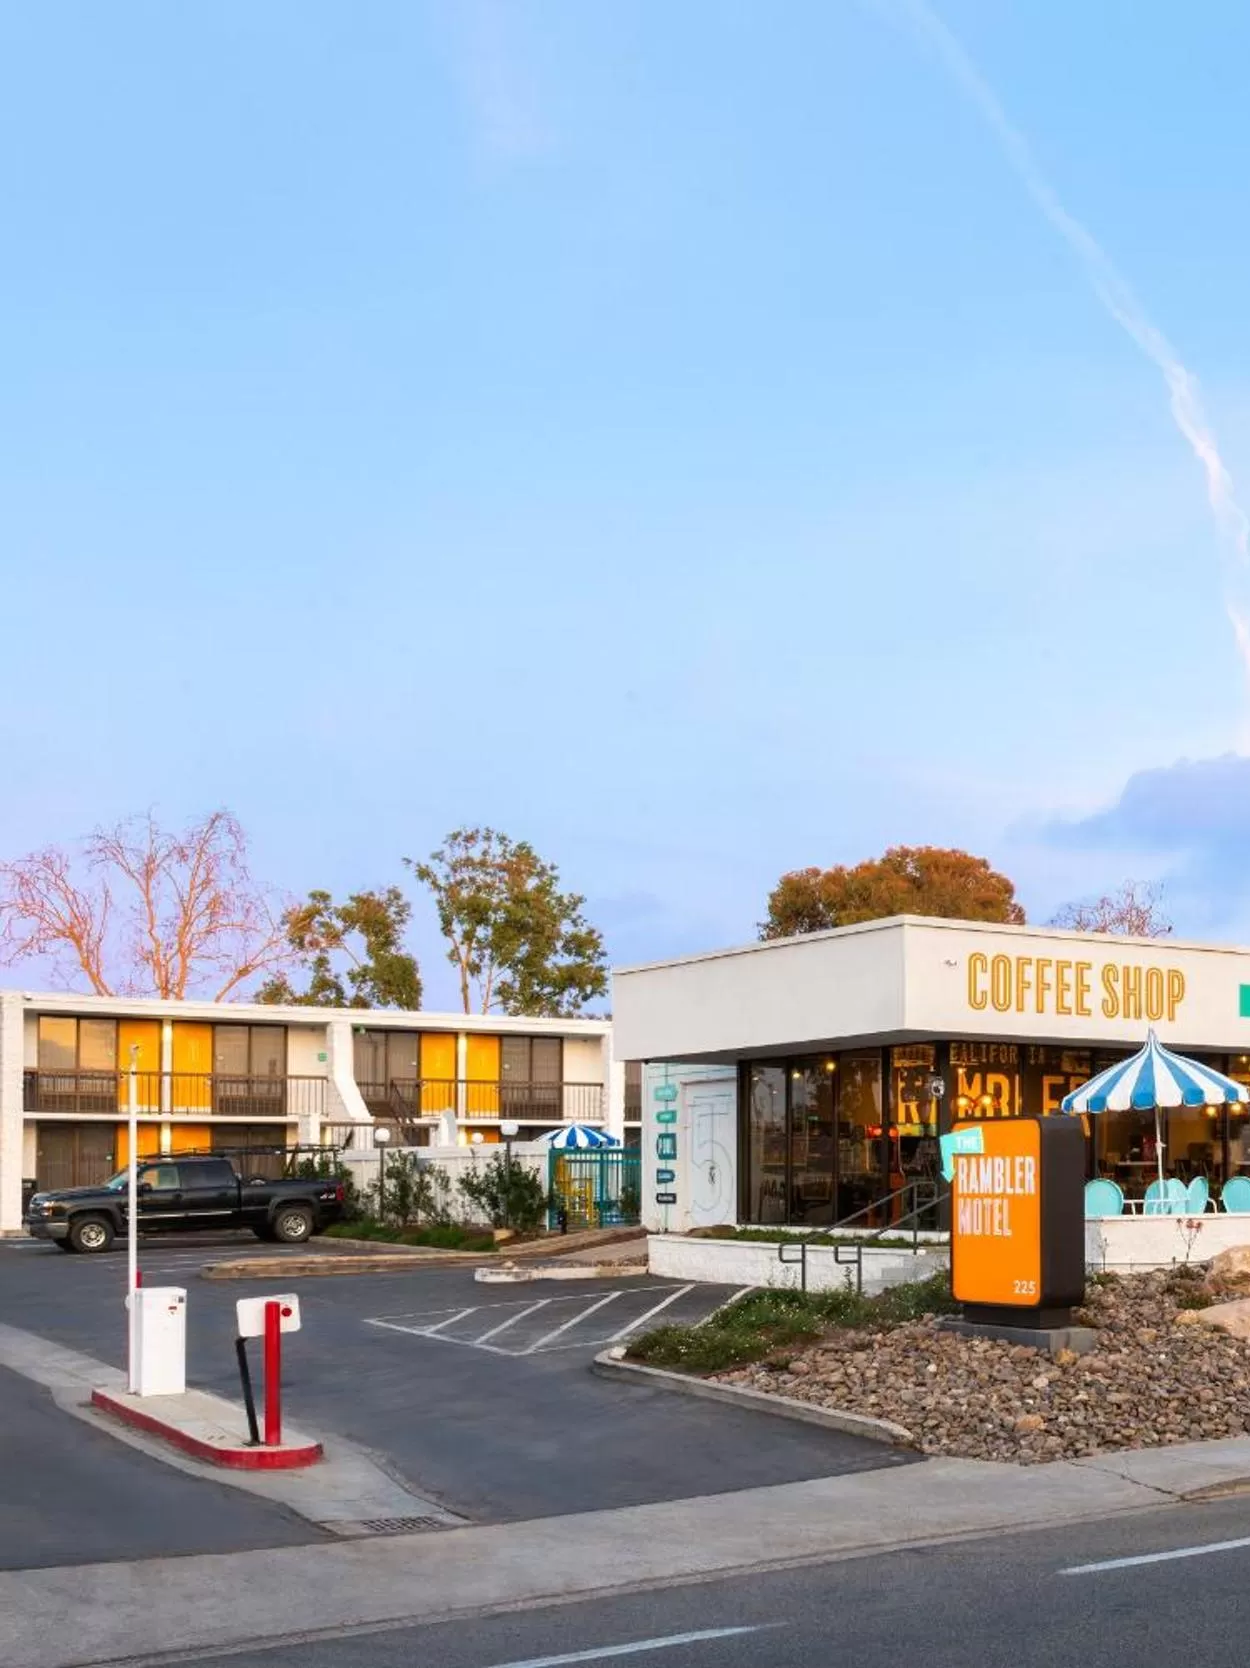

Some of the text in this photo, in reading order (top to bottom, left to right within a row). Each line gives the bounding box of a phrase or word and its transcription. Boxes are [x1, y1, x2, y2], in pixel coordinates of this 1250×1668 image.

[967, 952, 1186, 1022] COFFEE SHOP
[949, 1043, 1045, 1065] CALIFORIA
[955, 1136, 978, 1149] THE
[957, 1156, 1036, 1194] RAMBLER
[957, 1198, 1012, 1237] MOTEL
[1013, 1280, 1035, 1294] 225
